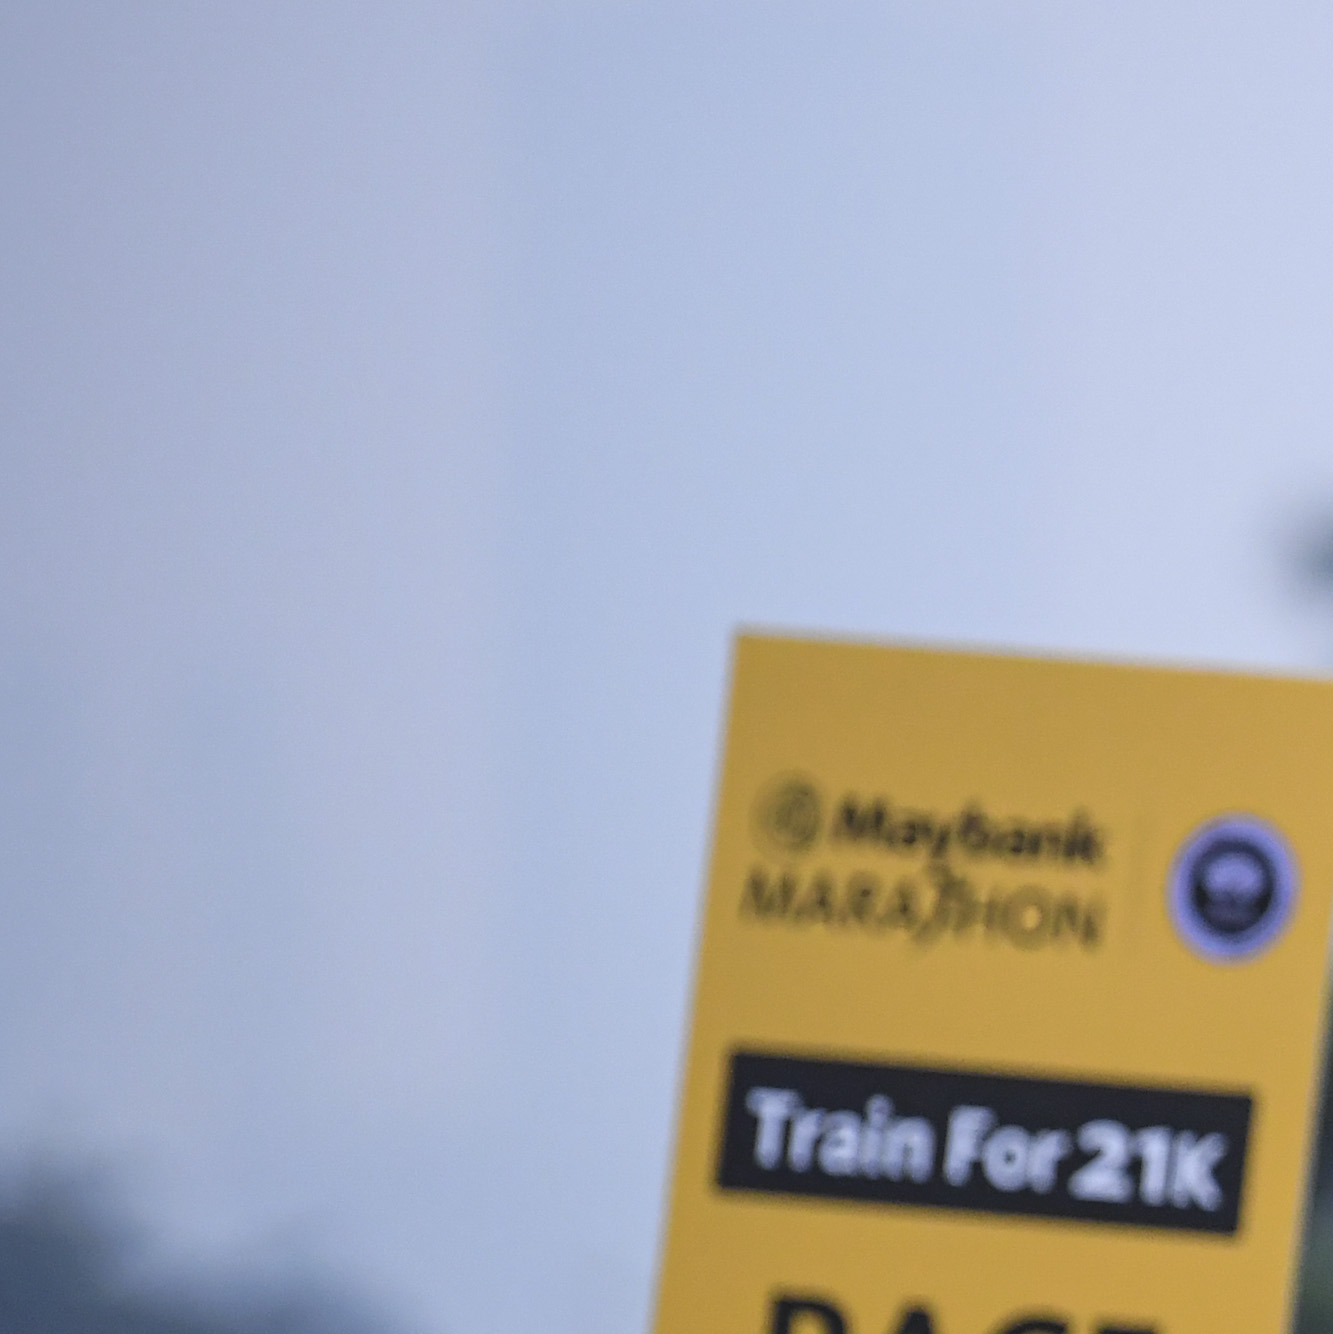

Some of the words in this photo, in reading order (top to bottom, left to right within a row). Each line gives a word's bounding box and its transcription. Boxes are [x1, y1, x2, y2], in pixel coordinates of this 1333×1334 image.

[831, 790, 1106, 868] Maybank
[748, 1086, 936, 1184] Train
[944, 1104, 1064, 1194] For
[1066, 1119, 1229, 1211] 21K
